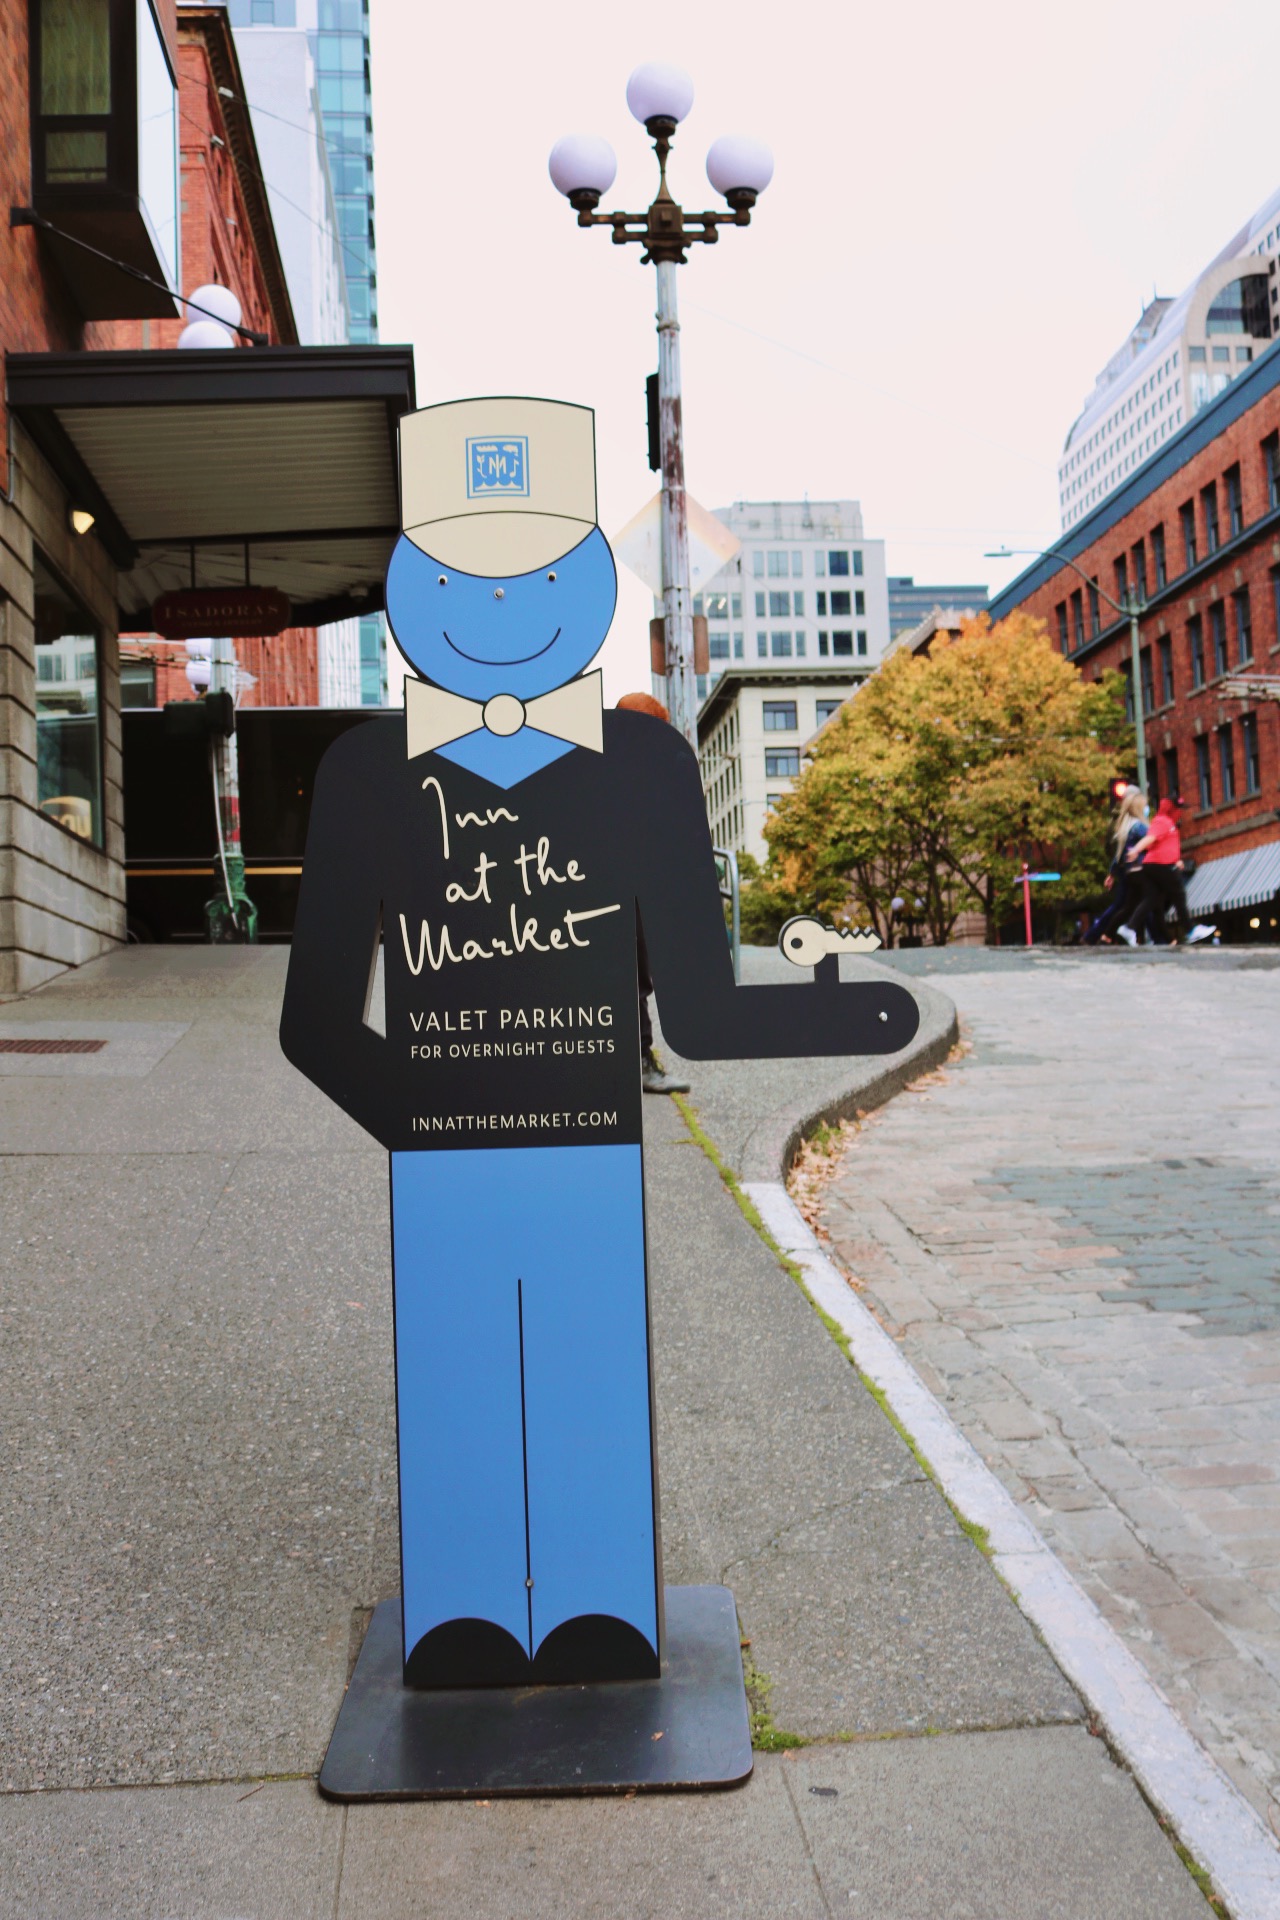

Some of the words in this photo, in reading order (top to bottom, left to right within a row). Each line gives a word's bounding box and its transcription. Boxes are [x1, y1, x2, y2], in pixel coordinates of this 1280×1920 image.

[422, 776, 519, 860] Inn
[445, 852, 498, 903] at
[513, 836, 586, 896] the
[399, 903, 621, 976] Market
[409, 1010, 488, 1032] VALET
[500, 1006, 614, 1030] PARKING
[411, 1045, 442, 1059] FOR
[449, 1041, 546, 1058] OVERNIGHT
[552, 1039, 616, 1055] GUESTS
[412, 1111, 618, 1132] INNATTHEMARKET.COM
